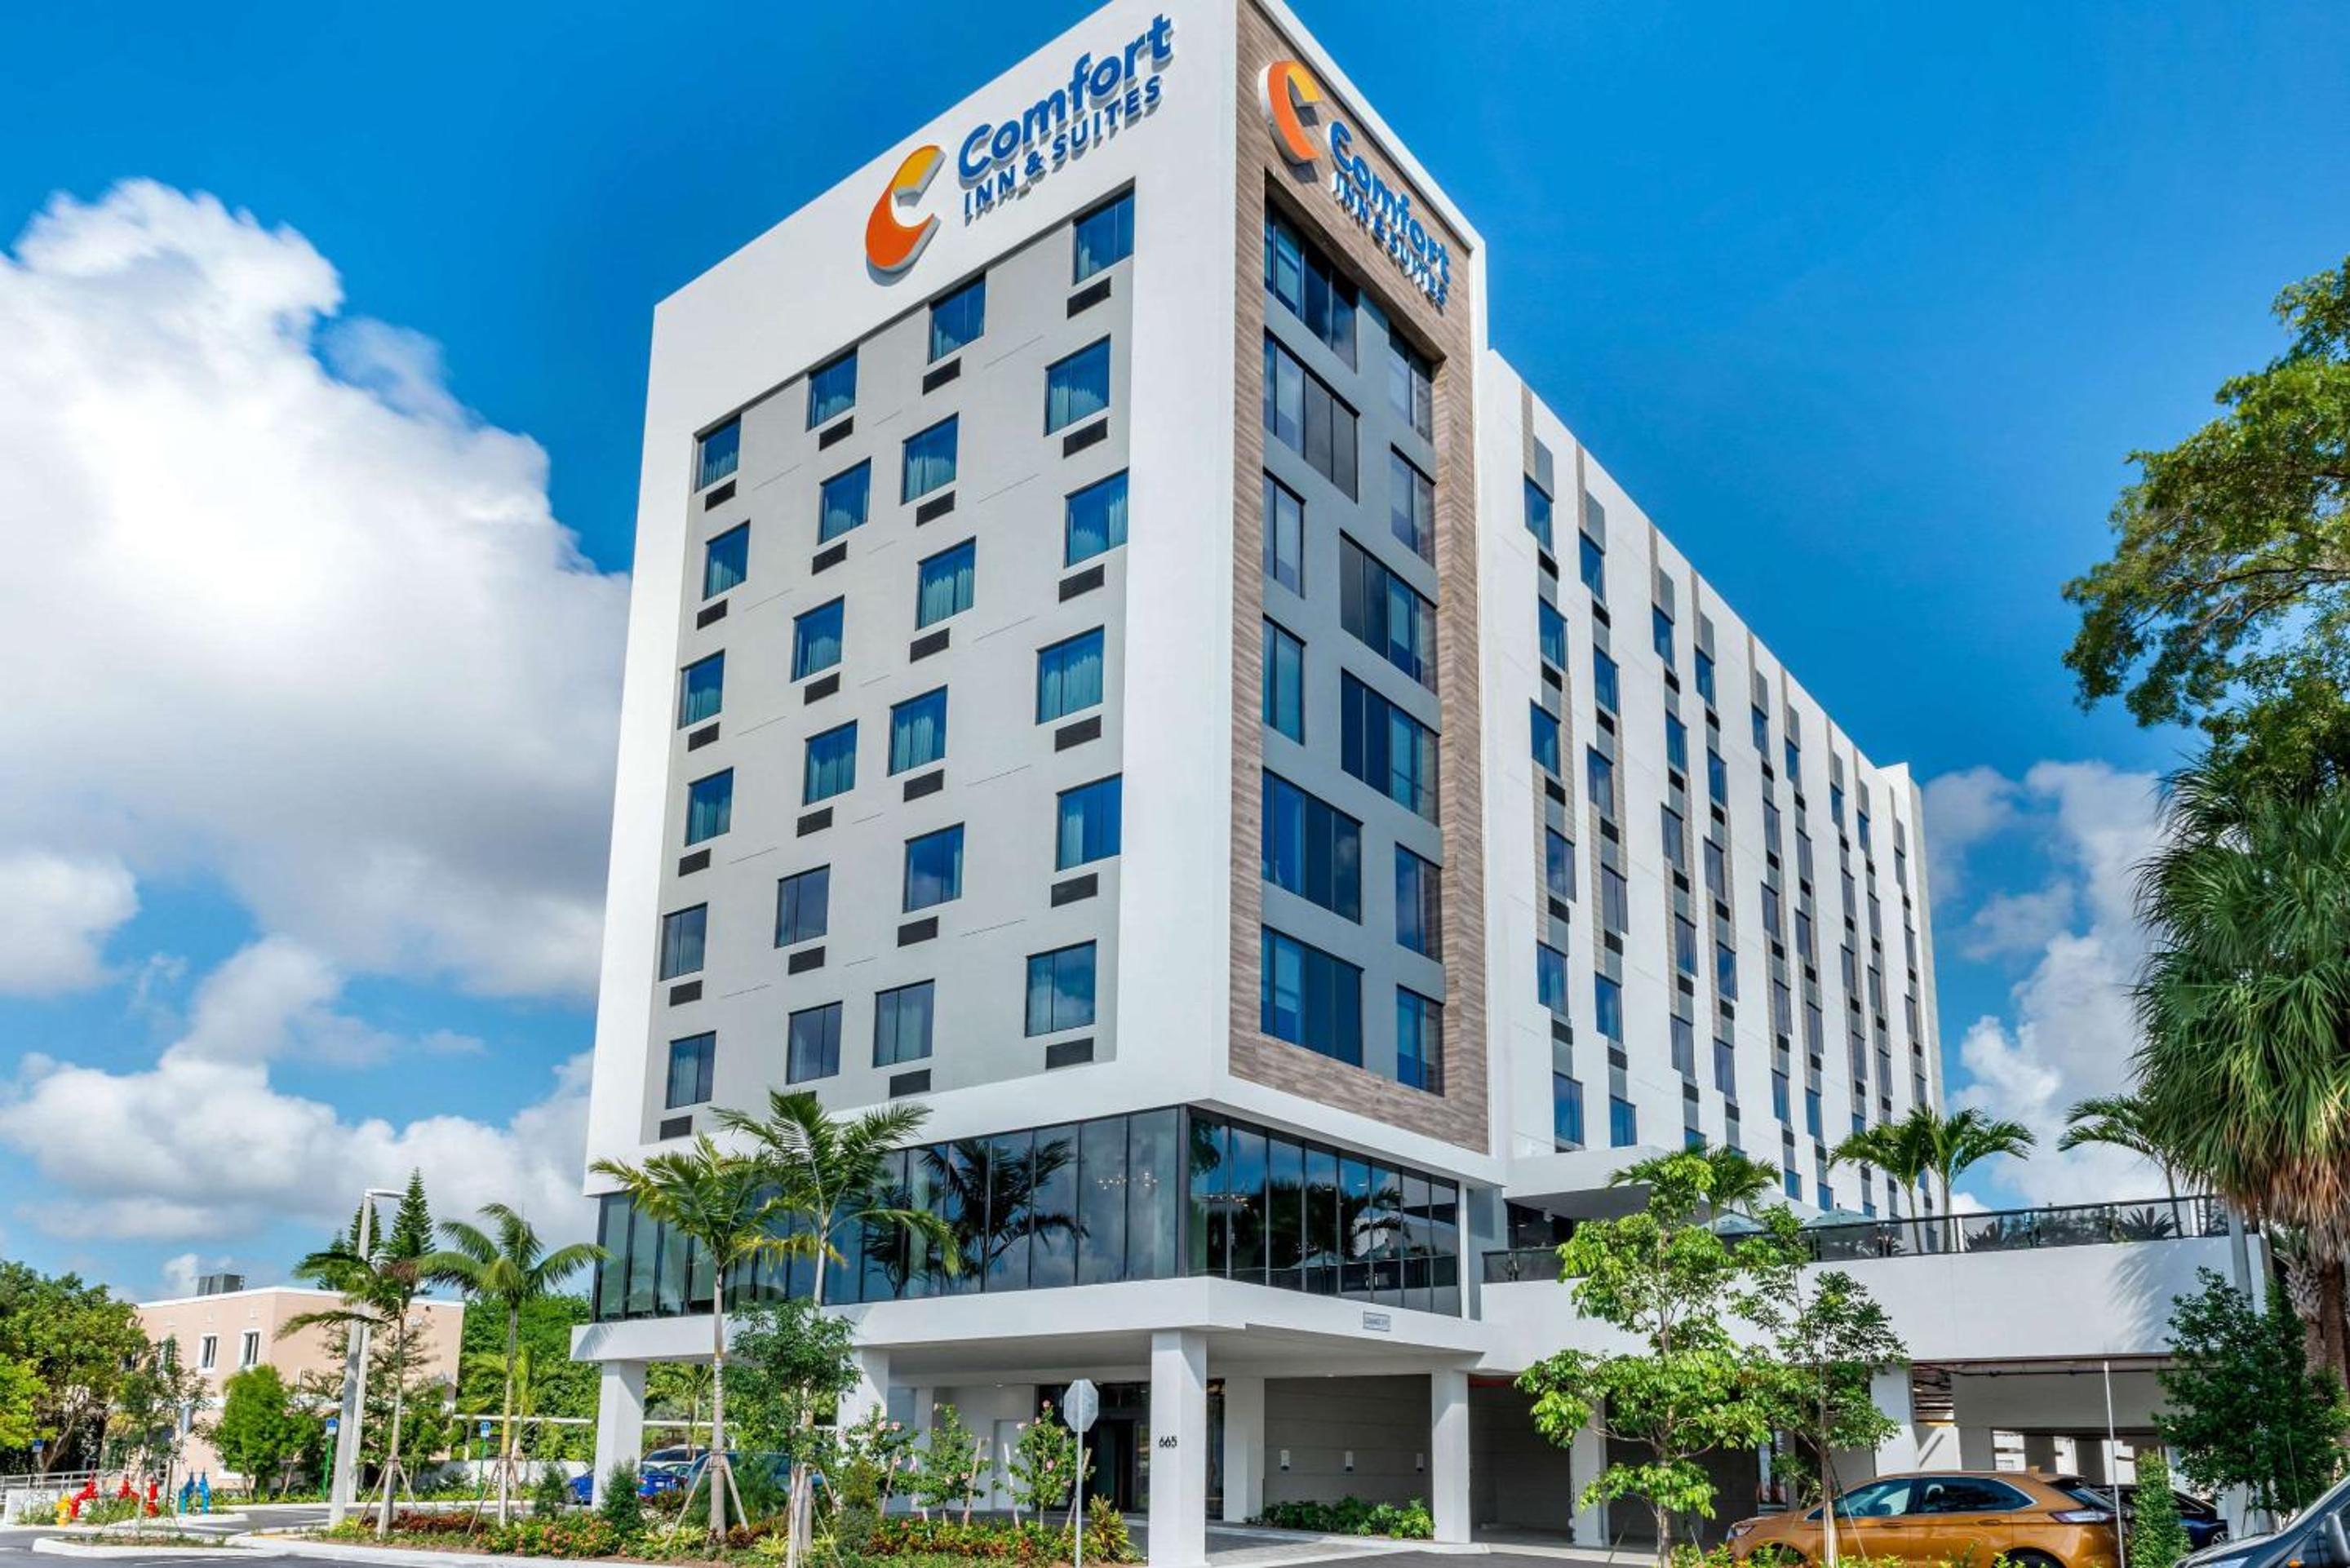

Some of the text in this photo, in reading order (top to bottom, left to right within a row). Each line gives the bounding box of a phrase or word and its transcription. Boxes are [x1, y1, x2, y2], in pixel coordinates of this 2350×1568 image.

[958, 13, 1172, 179] Comfort
[964, 75, 1161, 215] INN & SUITES
[1328, 120, 1450, 285] Comfort
[1159, 1436, 1177, 1449] 665
